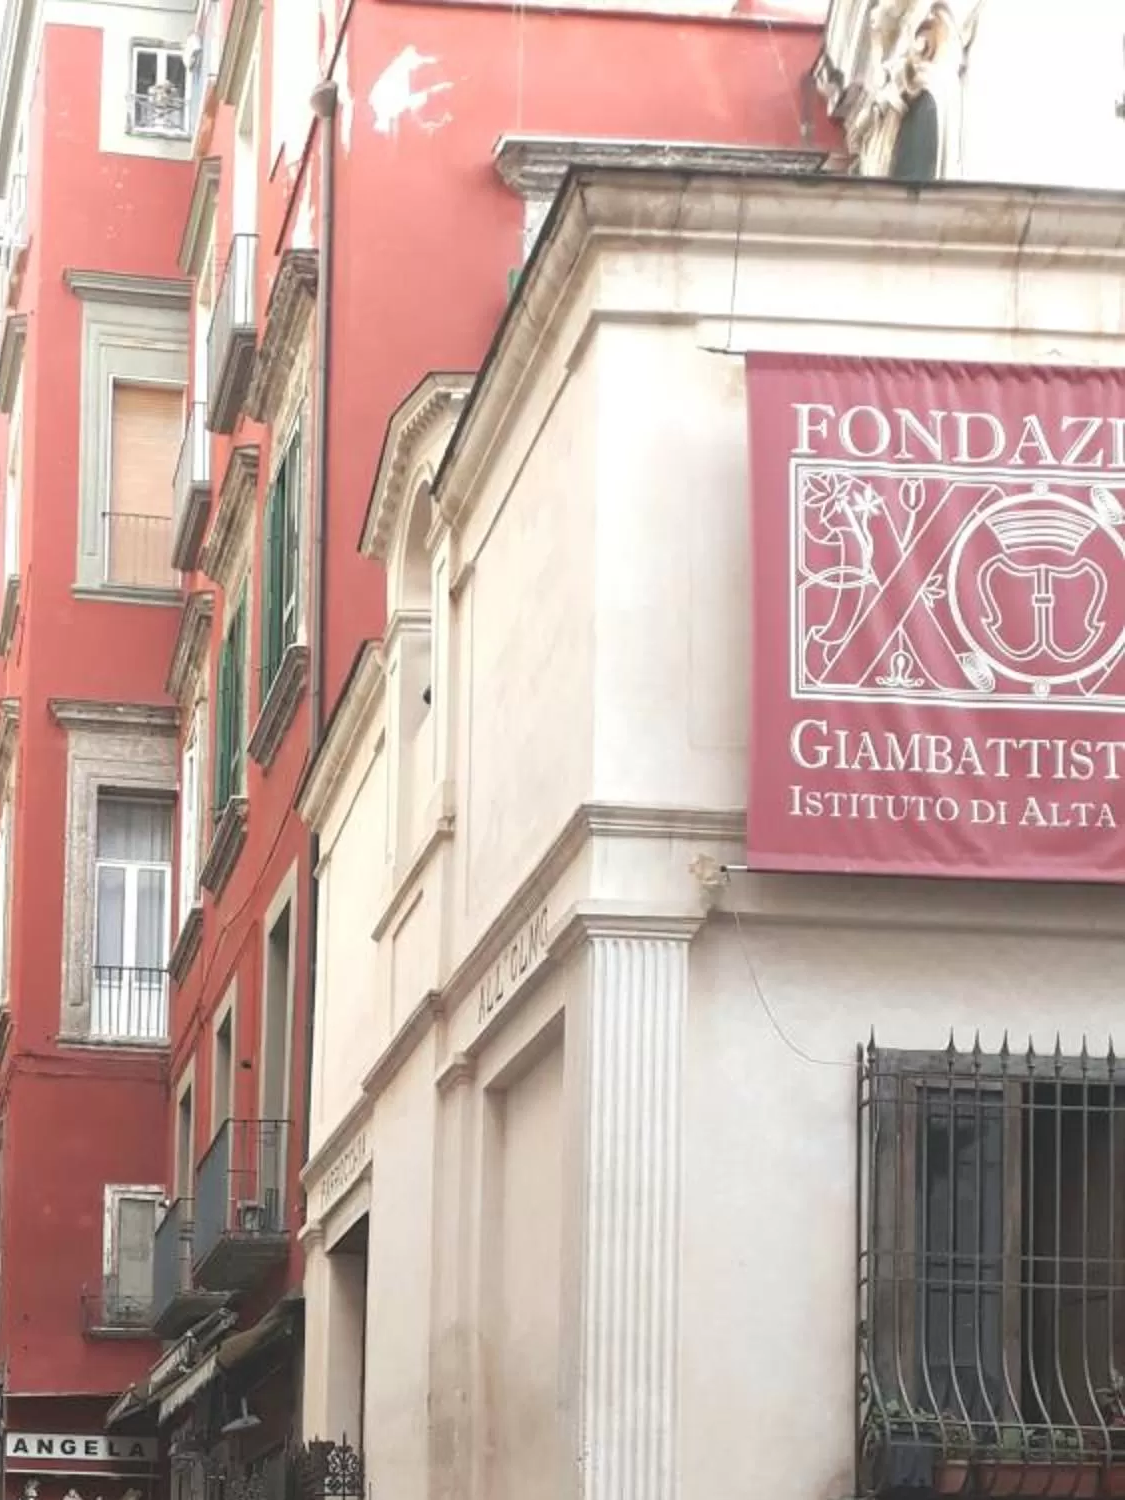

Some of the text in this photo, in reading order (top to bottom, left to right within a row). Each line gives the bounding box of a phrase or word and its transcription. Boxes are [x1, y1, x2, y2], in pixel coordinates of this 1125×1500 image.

[790, 402, 1125, 468] FONDAZI
[790, 719, 1125, 780] GIAMBATTIST
[789, 785, 1117, 828] ISTITUTO DI ALTA
[12, 1437, 145, 1457] ANGELA
